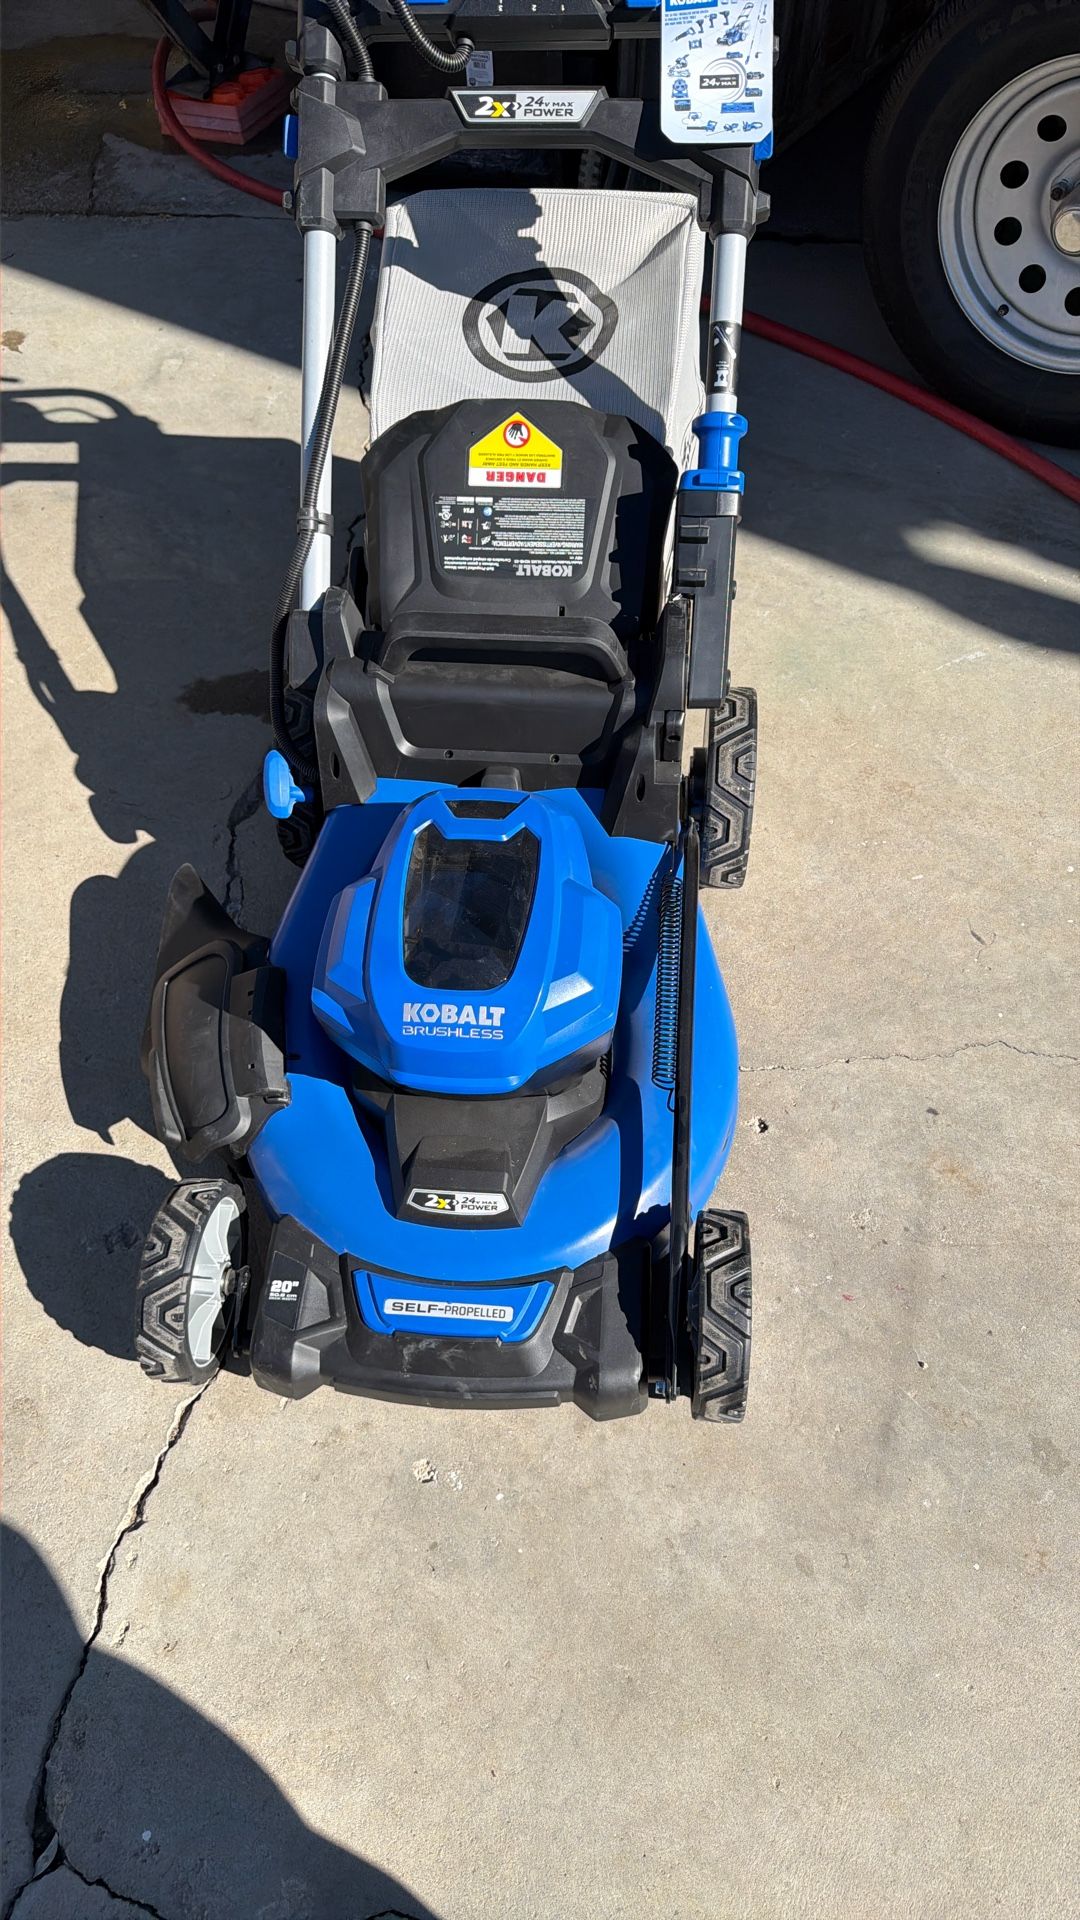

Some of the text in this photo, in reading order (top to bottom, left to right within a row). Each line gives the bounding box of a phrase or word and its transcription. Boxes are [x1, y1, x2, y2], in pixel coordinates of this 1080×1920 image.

[498, 4, 503, 12] 3
[532, 4, 537, 12] 2
[560, 4, 565, 12] 1
[524, 108, 573, 117] POWER
[486, 471, 546, 483] DANGER
[515, 564, 573, 577] KOBALT
[402, 1002, 505, 1027] KOBALT
[402, 1025, 504, 1040] BRUSHLESS
[270, 1280, 300, 1293] 20"
[391, 1301, 506, 1319] SELF-PROPELLED
